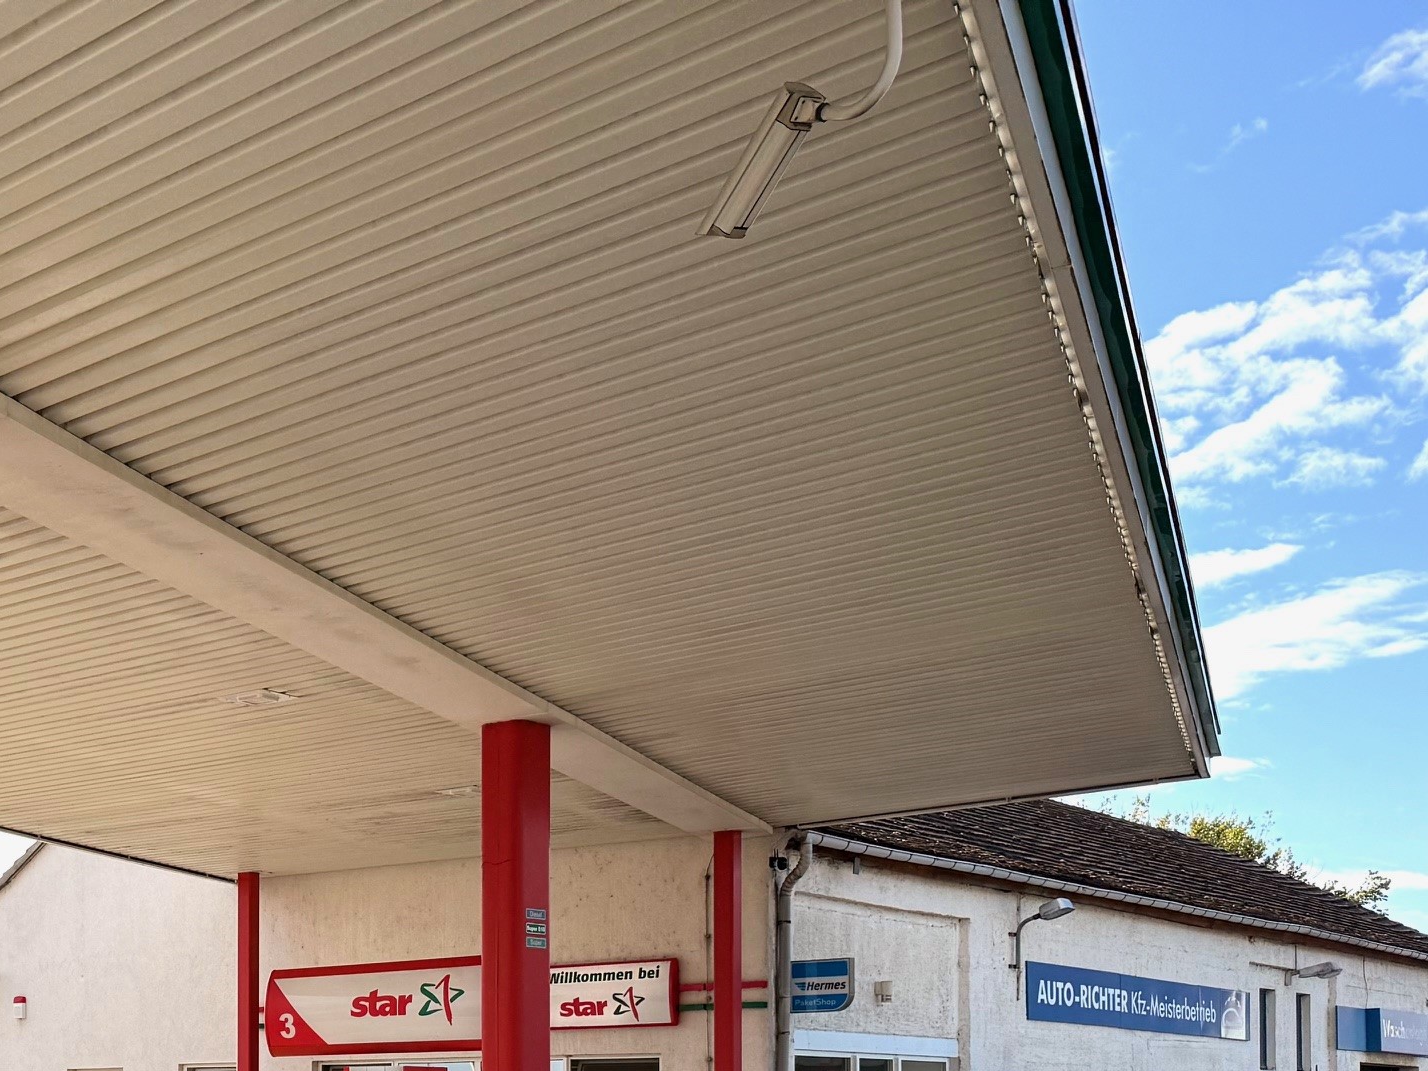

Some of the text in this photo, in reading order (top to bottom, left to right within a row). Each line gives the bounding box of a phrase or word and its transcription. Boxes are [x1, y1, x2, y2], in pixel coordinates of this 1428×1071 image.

[638, 965, 660, 979] bei
[806, 981, 847, 991] Hermes
[351, 989, 413, 1018] star
[559, 997, 608, 1017] star
[794, 998, 837, 1006] PaketShop
[1037, 980, 1217, 1024] AUTO-RICHTER Kfz-Meisterbetrieb
[278, 1012, 297, 1039] 3
